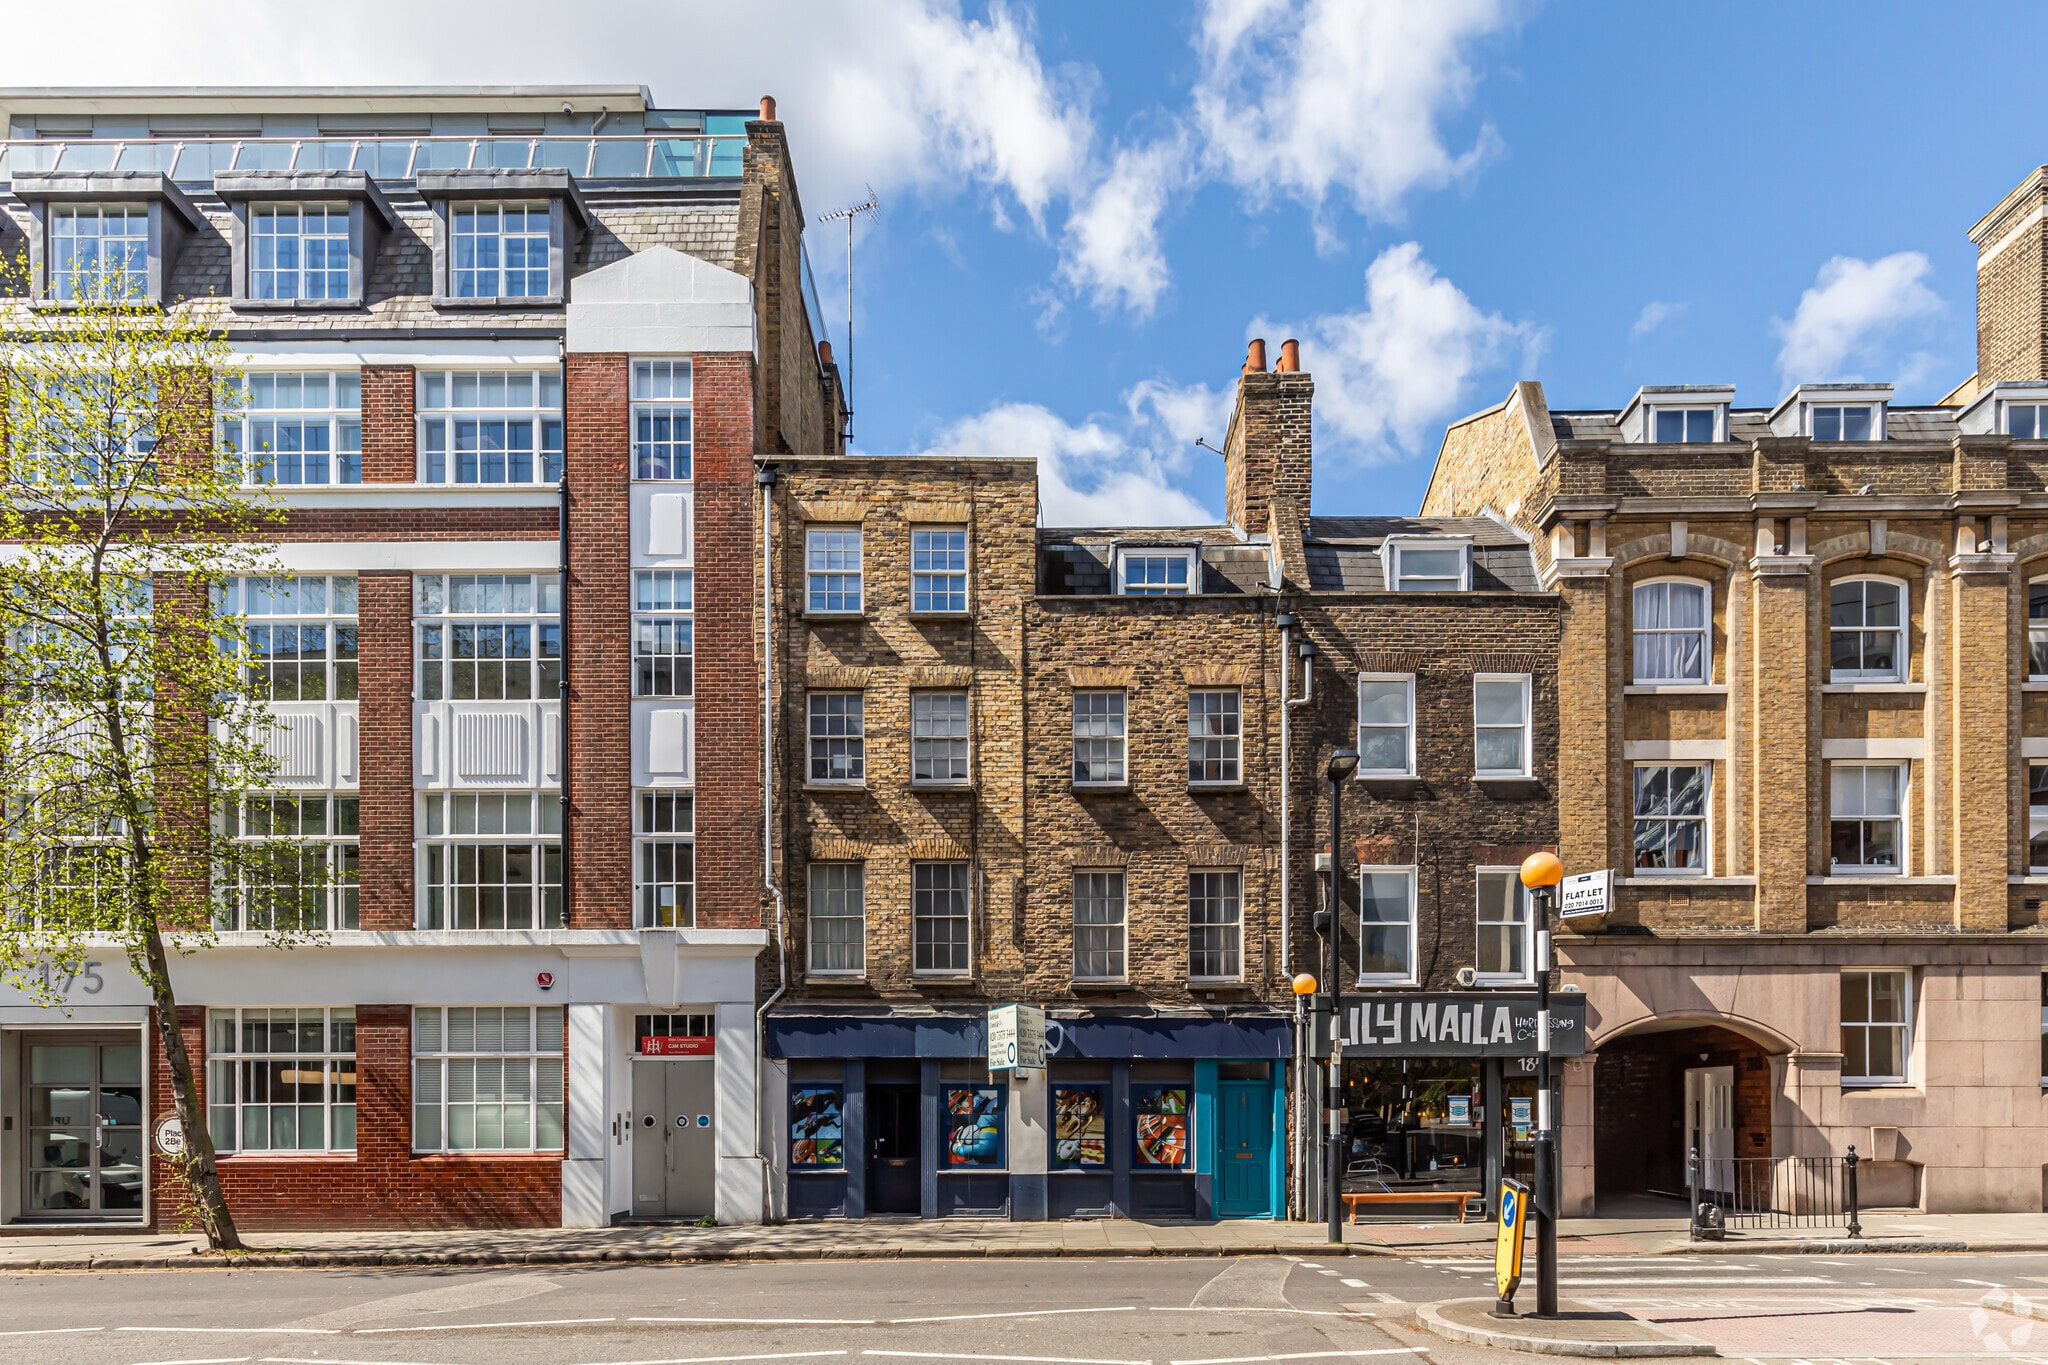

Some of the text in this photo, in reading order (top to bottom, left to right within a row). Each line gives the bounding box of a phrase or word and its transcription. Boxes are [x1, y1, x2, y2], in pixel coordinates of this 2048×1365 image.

[1565, 887, 1603, 901] FLAT LET
[38, 961, 104, 994] 175
[1331, 1002, 1513, 1046] ILY MAILA
[165, 1129, 183, 1137] Plac
[165, 1137, 181, 1145] 2Be
